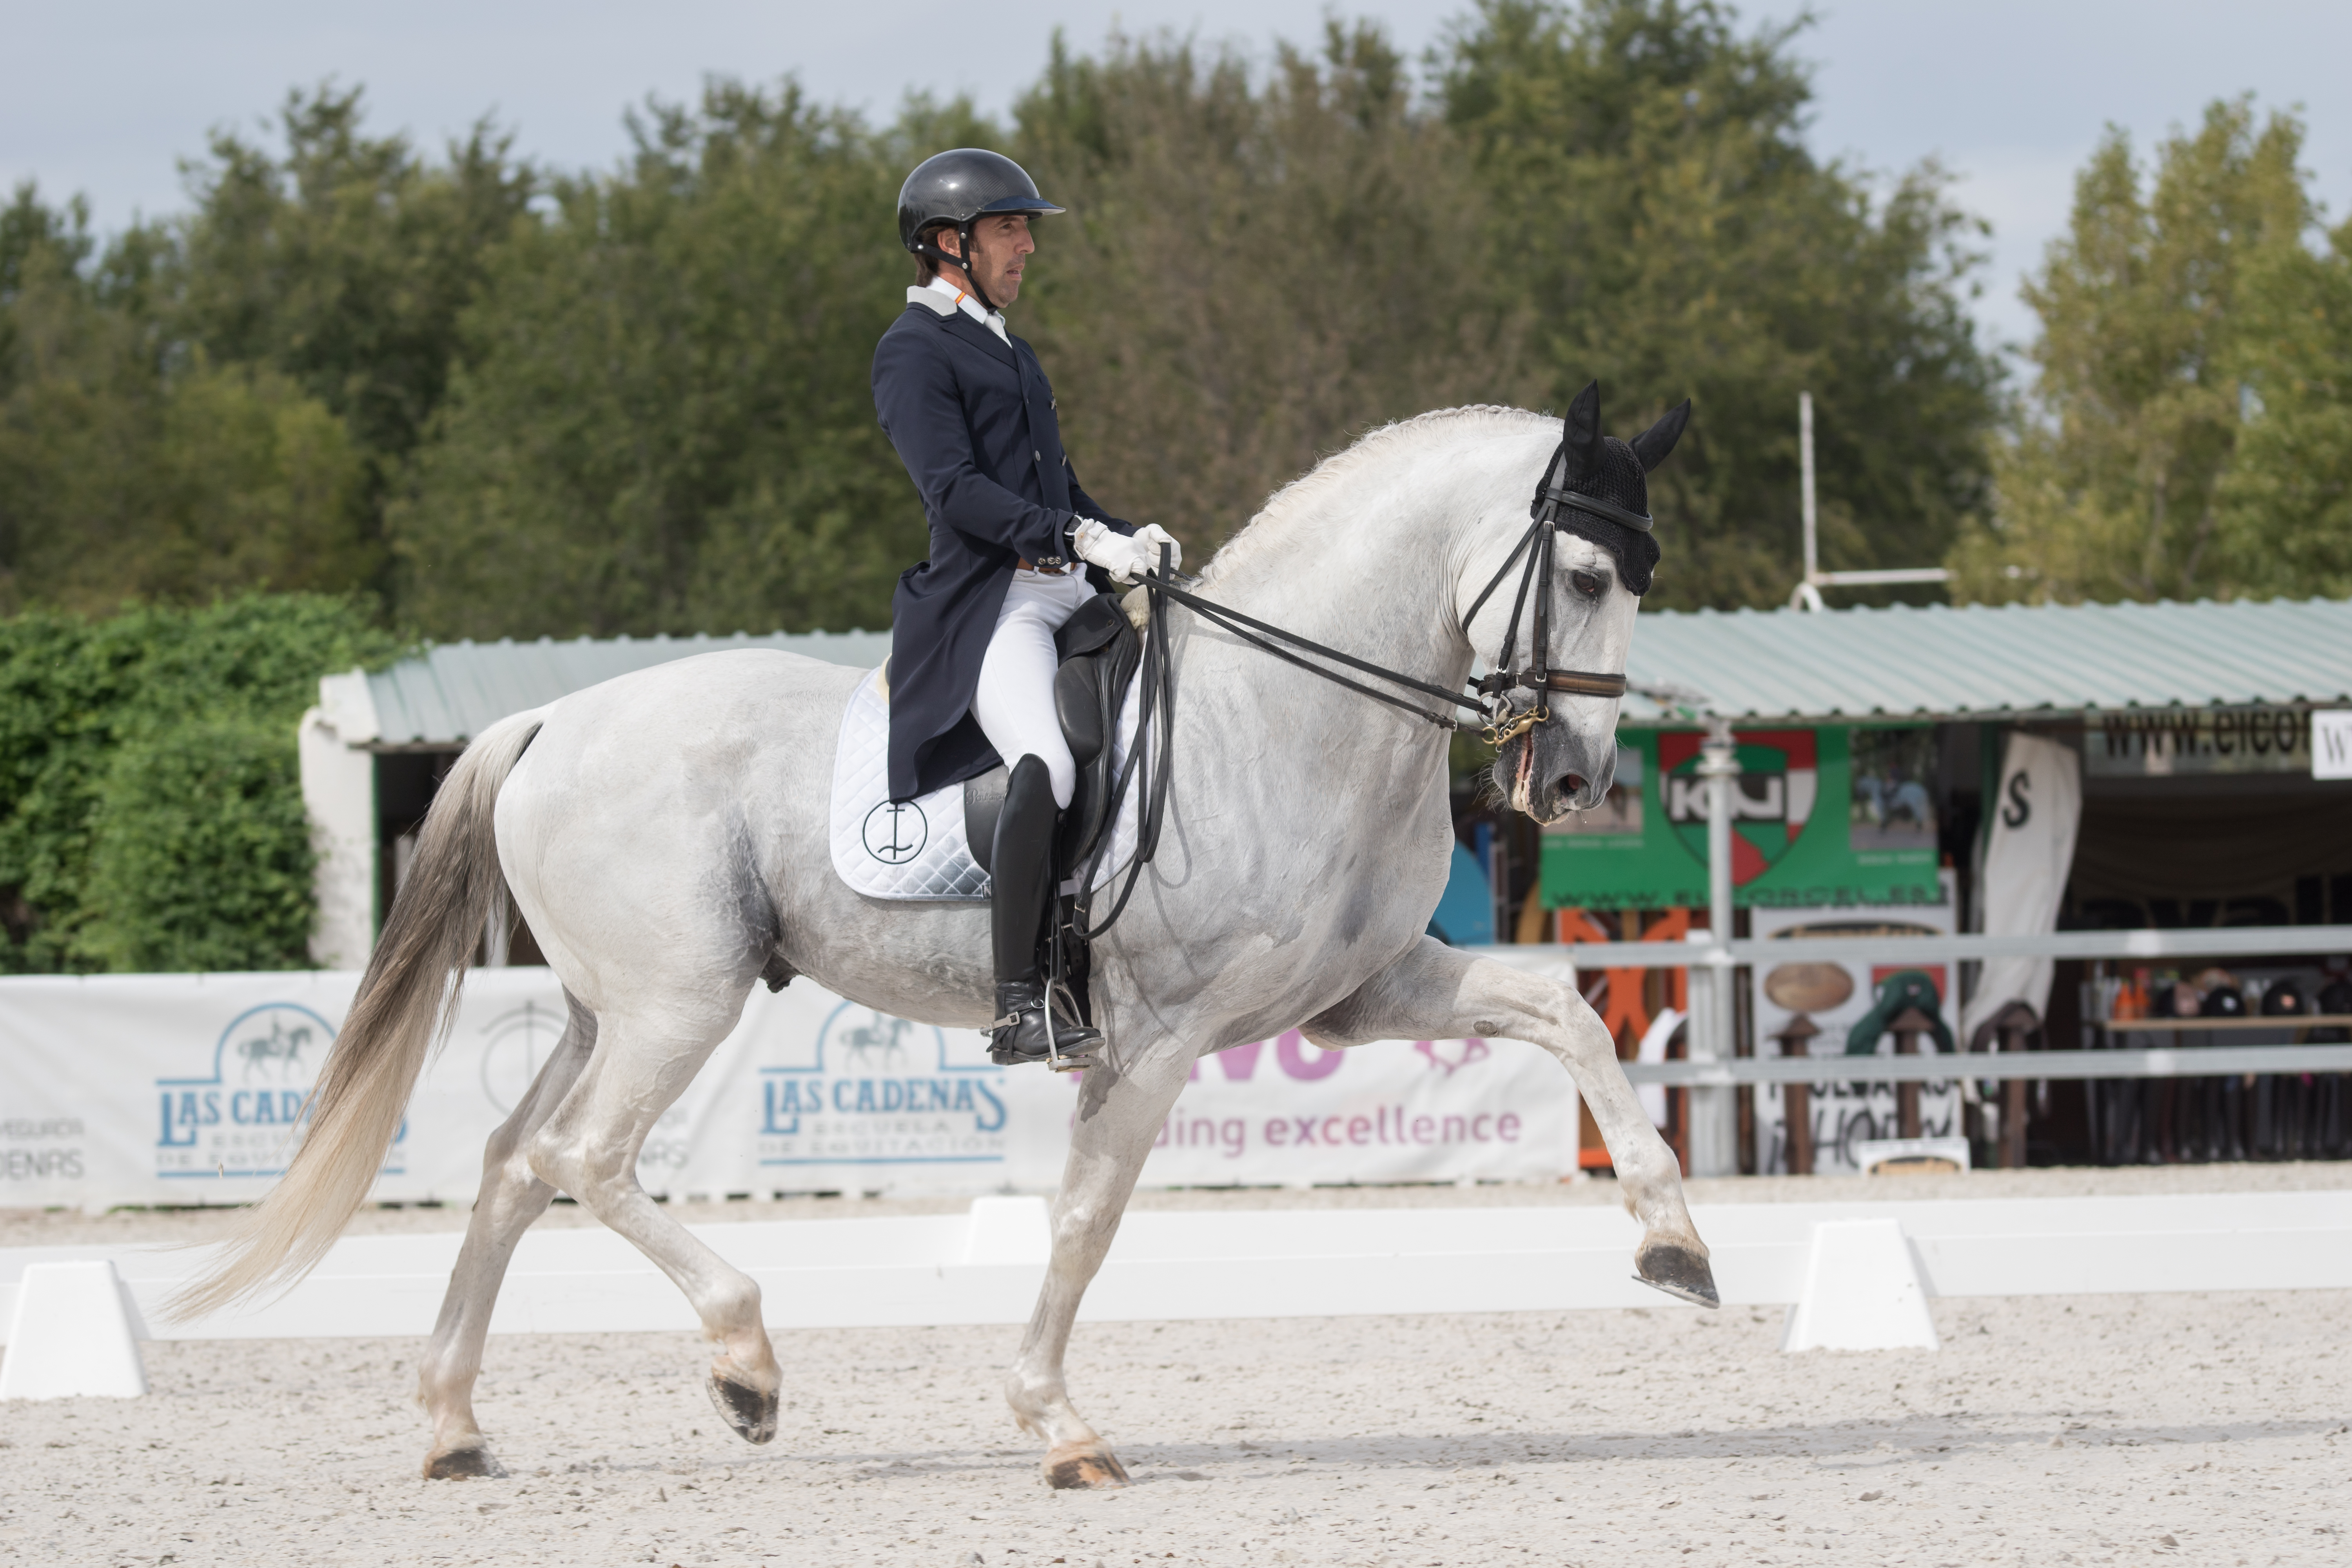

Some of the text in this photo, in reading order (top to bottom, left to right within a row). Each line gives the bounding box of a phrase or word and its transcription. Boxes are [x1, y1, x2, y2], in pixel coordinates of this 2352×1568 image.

[156, 1092, 221, 1147] LAS
[760, 1078, 1007, 1134] LAS CADENAS
[1264, 1102, 1521, 1145] excellence
